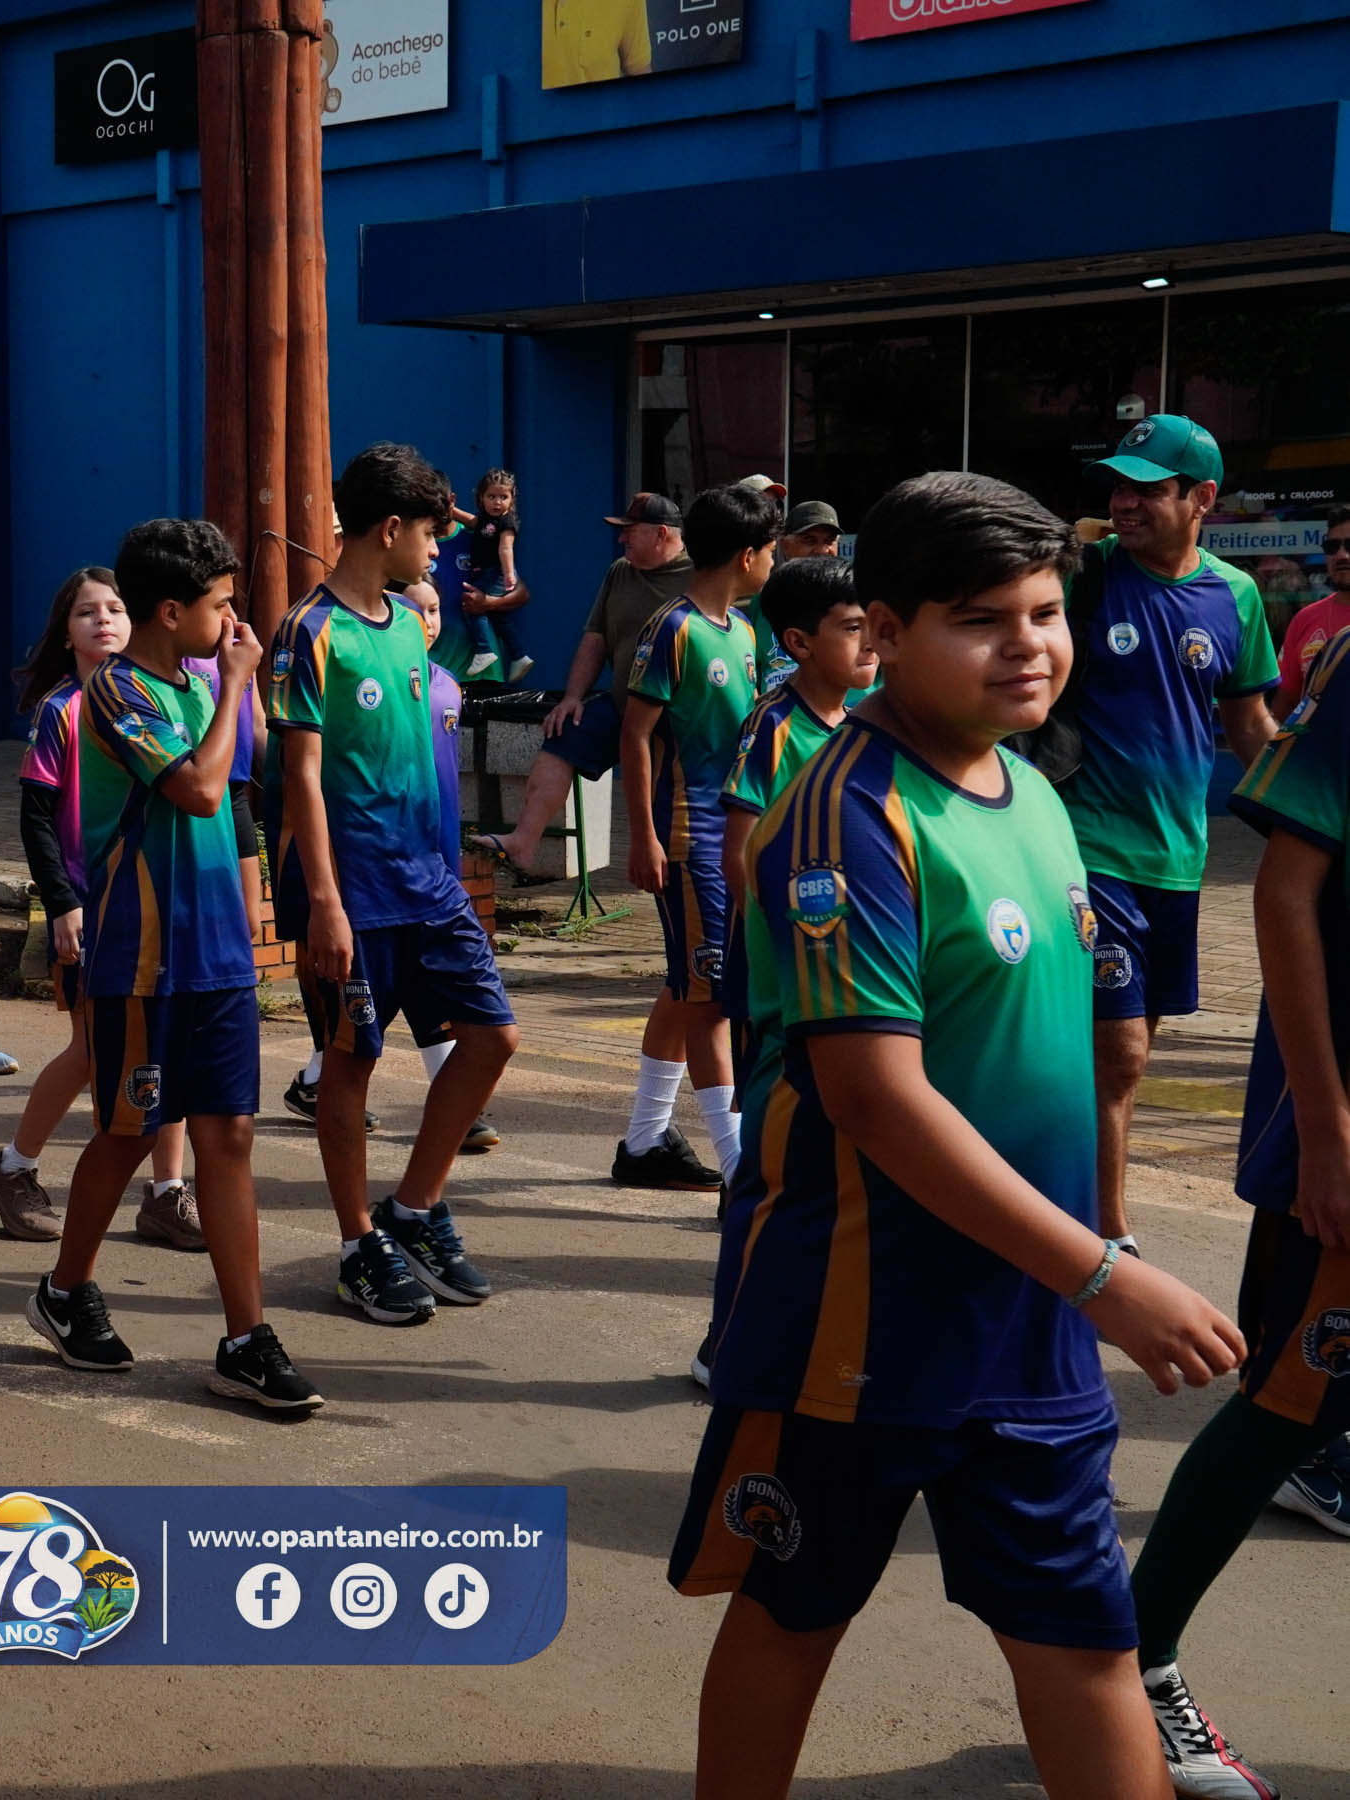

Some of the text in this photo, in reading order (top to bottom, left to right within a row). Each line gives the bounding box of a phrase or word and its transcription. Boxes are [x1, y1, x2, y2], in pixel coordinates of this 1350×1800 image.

[656, 18, 740, 44] POLO ONE
[352, 34, 443, 61] Aconchego
[352, 56, 421, 84] do bebê
[96, 120, 153, 138] OGOCHI
[1244, 491, 1275, 501] MODAS
[1290, 489, 1334, 501] CALÇADOS
[1208, 531, 1297, 549] Feiticeira
[799, 878, 834, 898] CBFS
[1095, 949, 1123, 960] BONITO
[747, 1479, 790, 1515] BONITO
